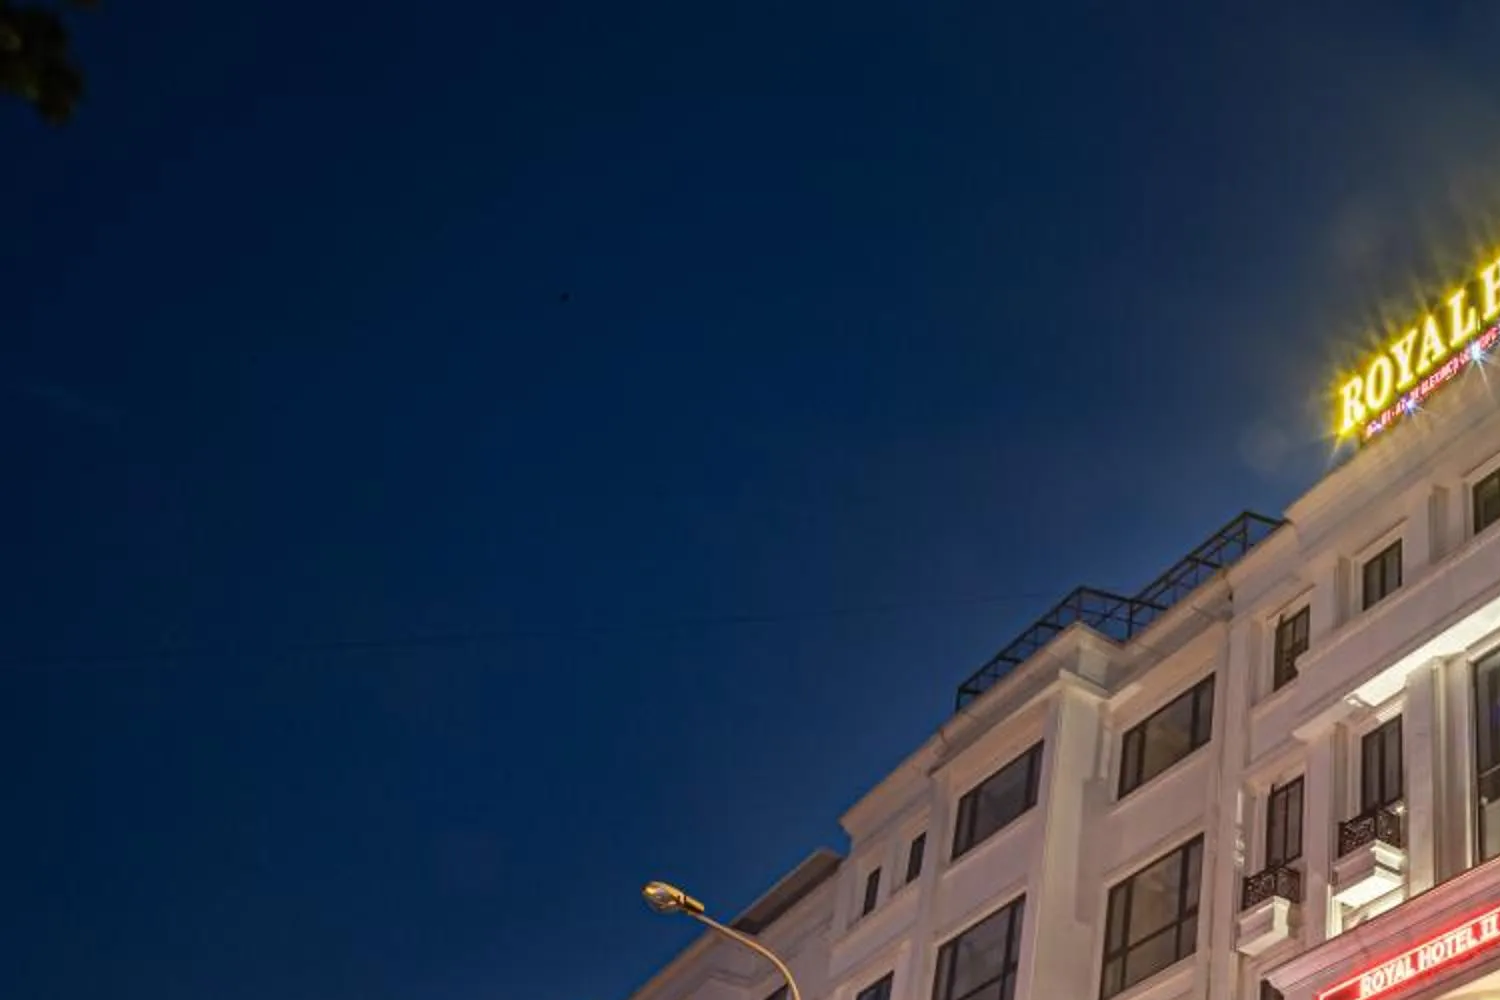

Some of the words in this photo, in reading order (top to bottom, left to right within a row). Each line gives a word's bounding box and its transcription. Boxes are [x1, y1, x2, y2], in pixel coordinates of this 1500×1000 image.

[1340, 288, 1478, 434] ROYAL
[1360, 952, 1416, 998] ROYAL
[1417, 926, 1480, 971] HOTEL
